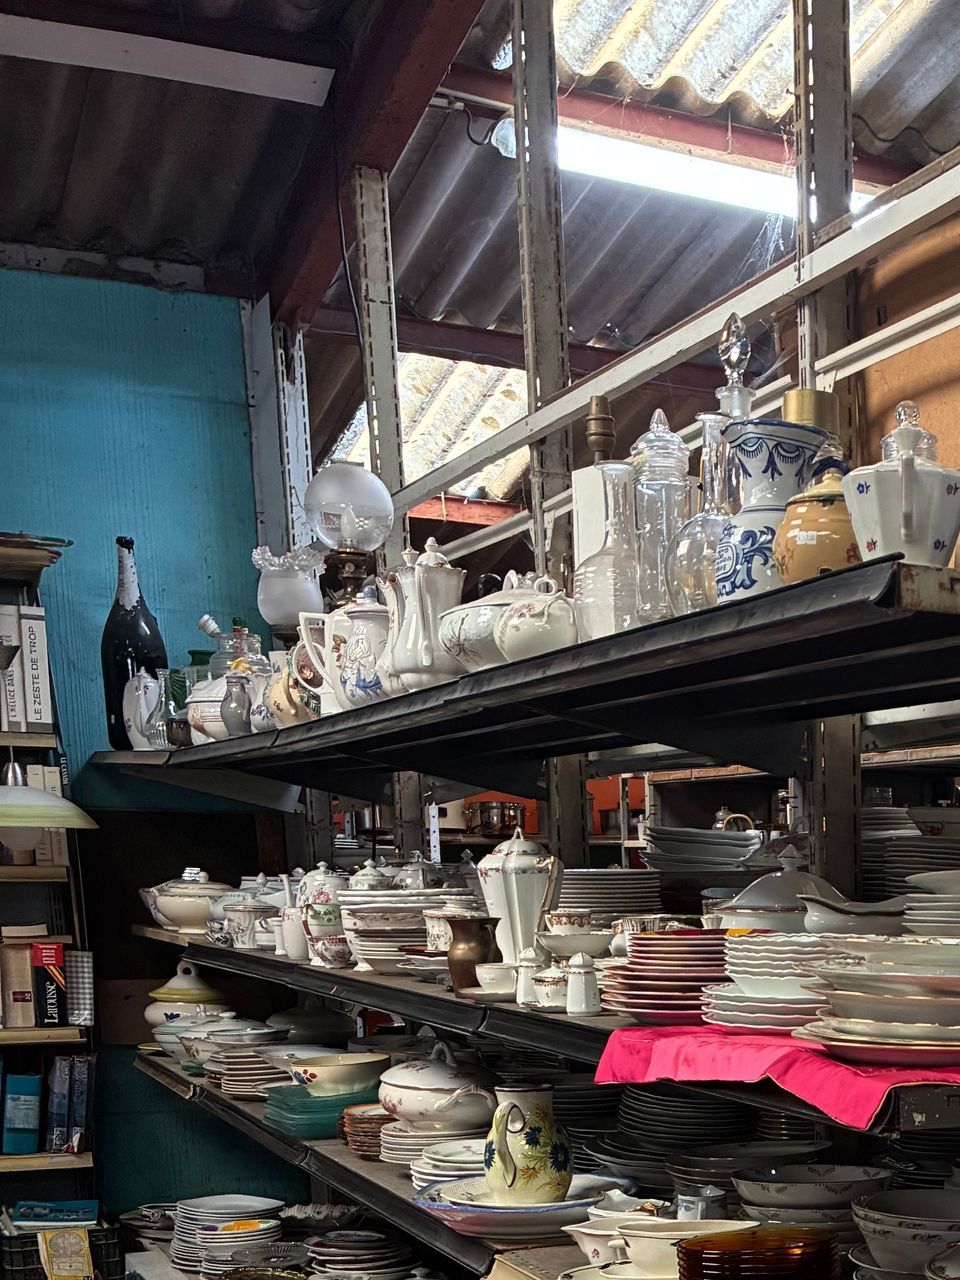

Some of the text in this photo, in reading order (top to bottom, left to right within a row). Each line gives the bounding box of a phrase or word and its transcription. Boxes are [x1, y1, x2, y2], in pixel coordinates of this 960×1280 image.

[28, 625, 43, 721] LE ZESTE DE TROP
[44, 981, 59, 1024] Larousse
